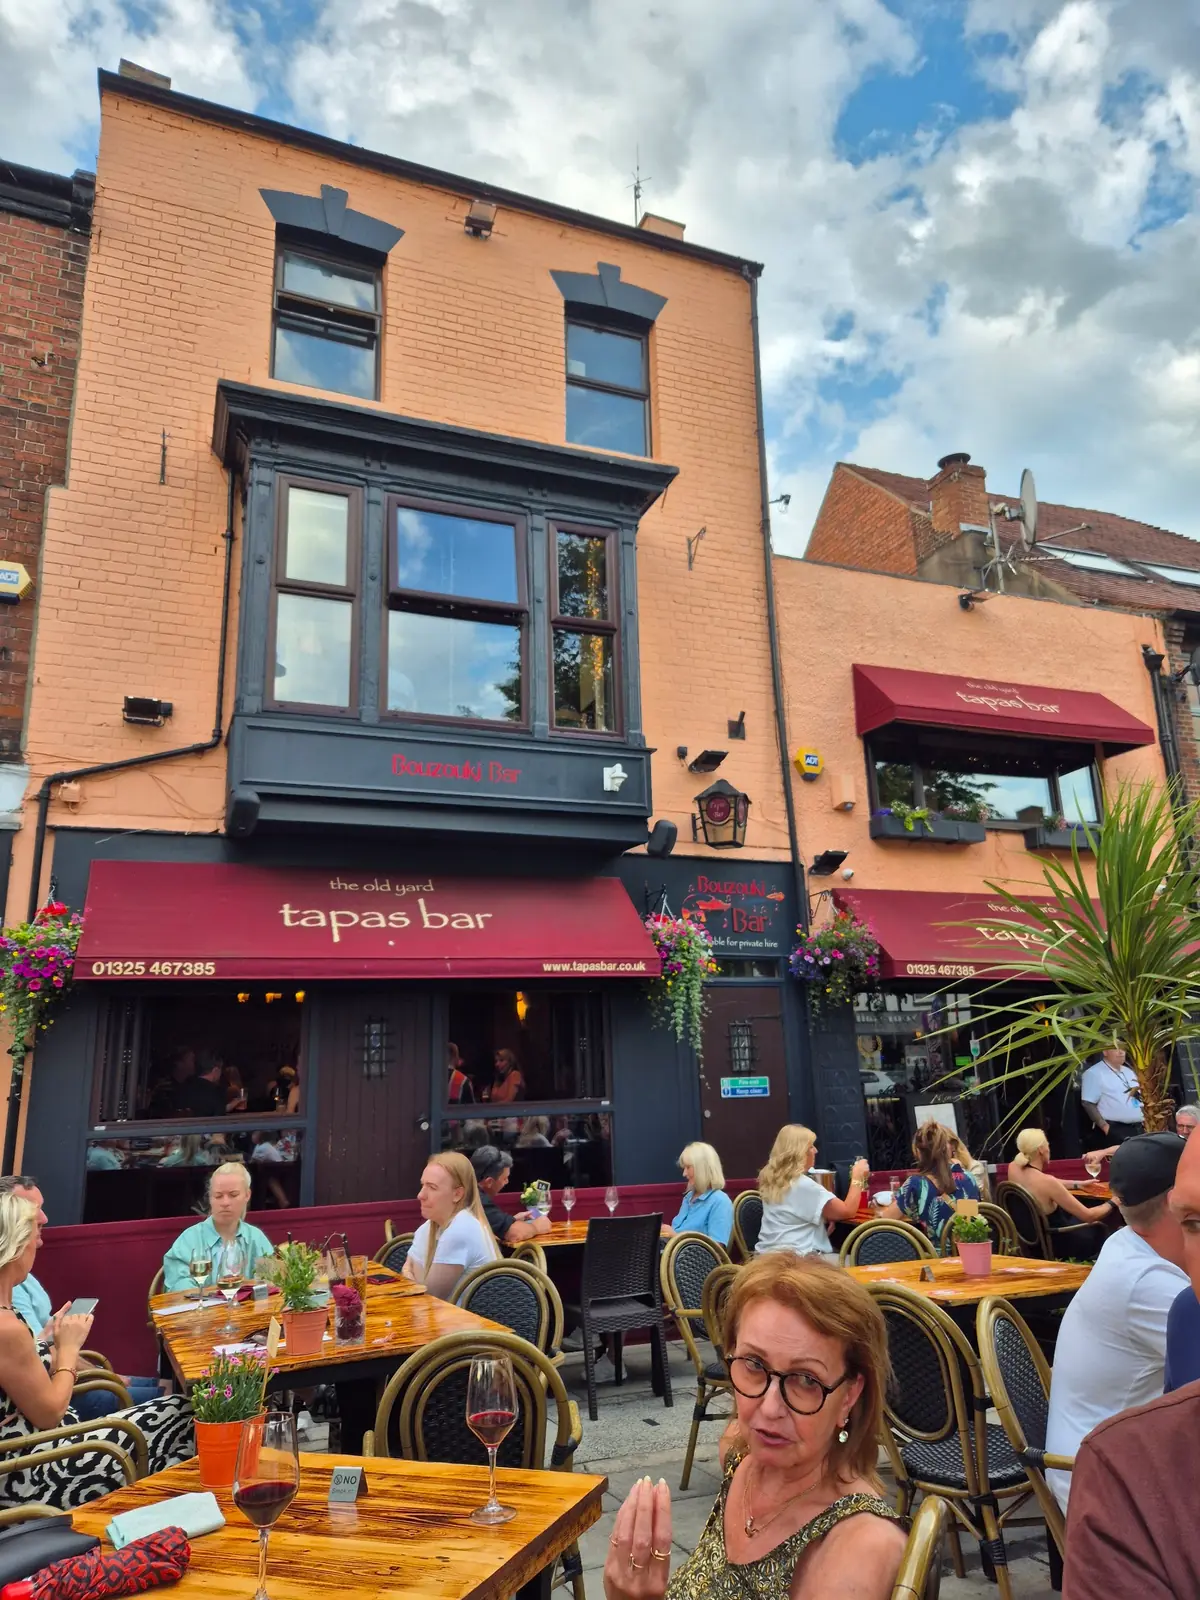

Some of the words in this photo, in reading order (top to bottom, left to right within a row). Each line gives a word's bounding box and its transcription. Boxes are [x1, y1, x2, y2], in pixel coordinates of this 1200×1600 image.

[956, 691, 1022, 712] tapas
[1016, 695, 1060, 713] bar
[391, 753, 482, 782] Bouzouki
[489, 761, 522, 783] Bar
[805, 756, 818, 766] ADT
[329, 877, 359, 891] the
[363, 878, 391, 892] old
[395, 879, 435, 896] yard
[697, 875, 766, 897] Bouzouki
[987, 903, 1009, 913] the
[278, 903, 411, 943] tapas
[417, 898, 493, 929] bar
[731, 908, 768, 933] Bar
[726, 936, 738, 946] for
[738, 939, 763, 950] private
[764, 939, 778, 948] hire
[91, 961, 146, 976] 01325
[149, 961, 217, 976] 467385
[542, 961, 647, 973] www.tapasbar.co.uk
[906, 963, 936, 975] 01325
[938, 965, 975, 976] 467385
[343, 1476, 357, 1484] NO
